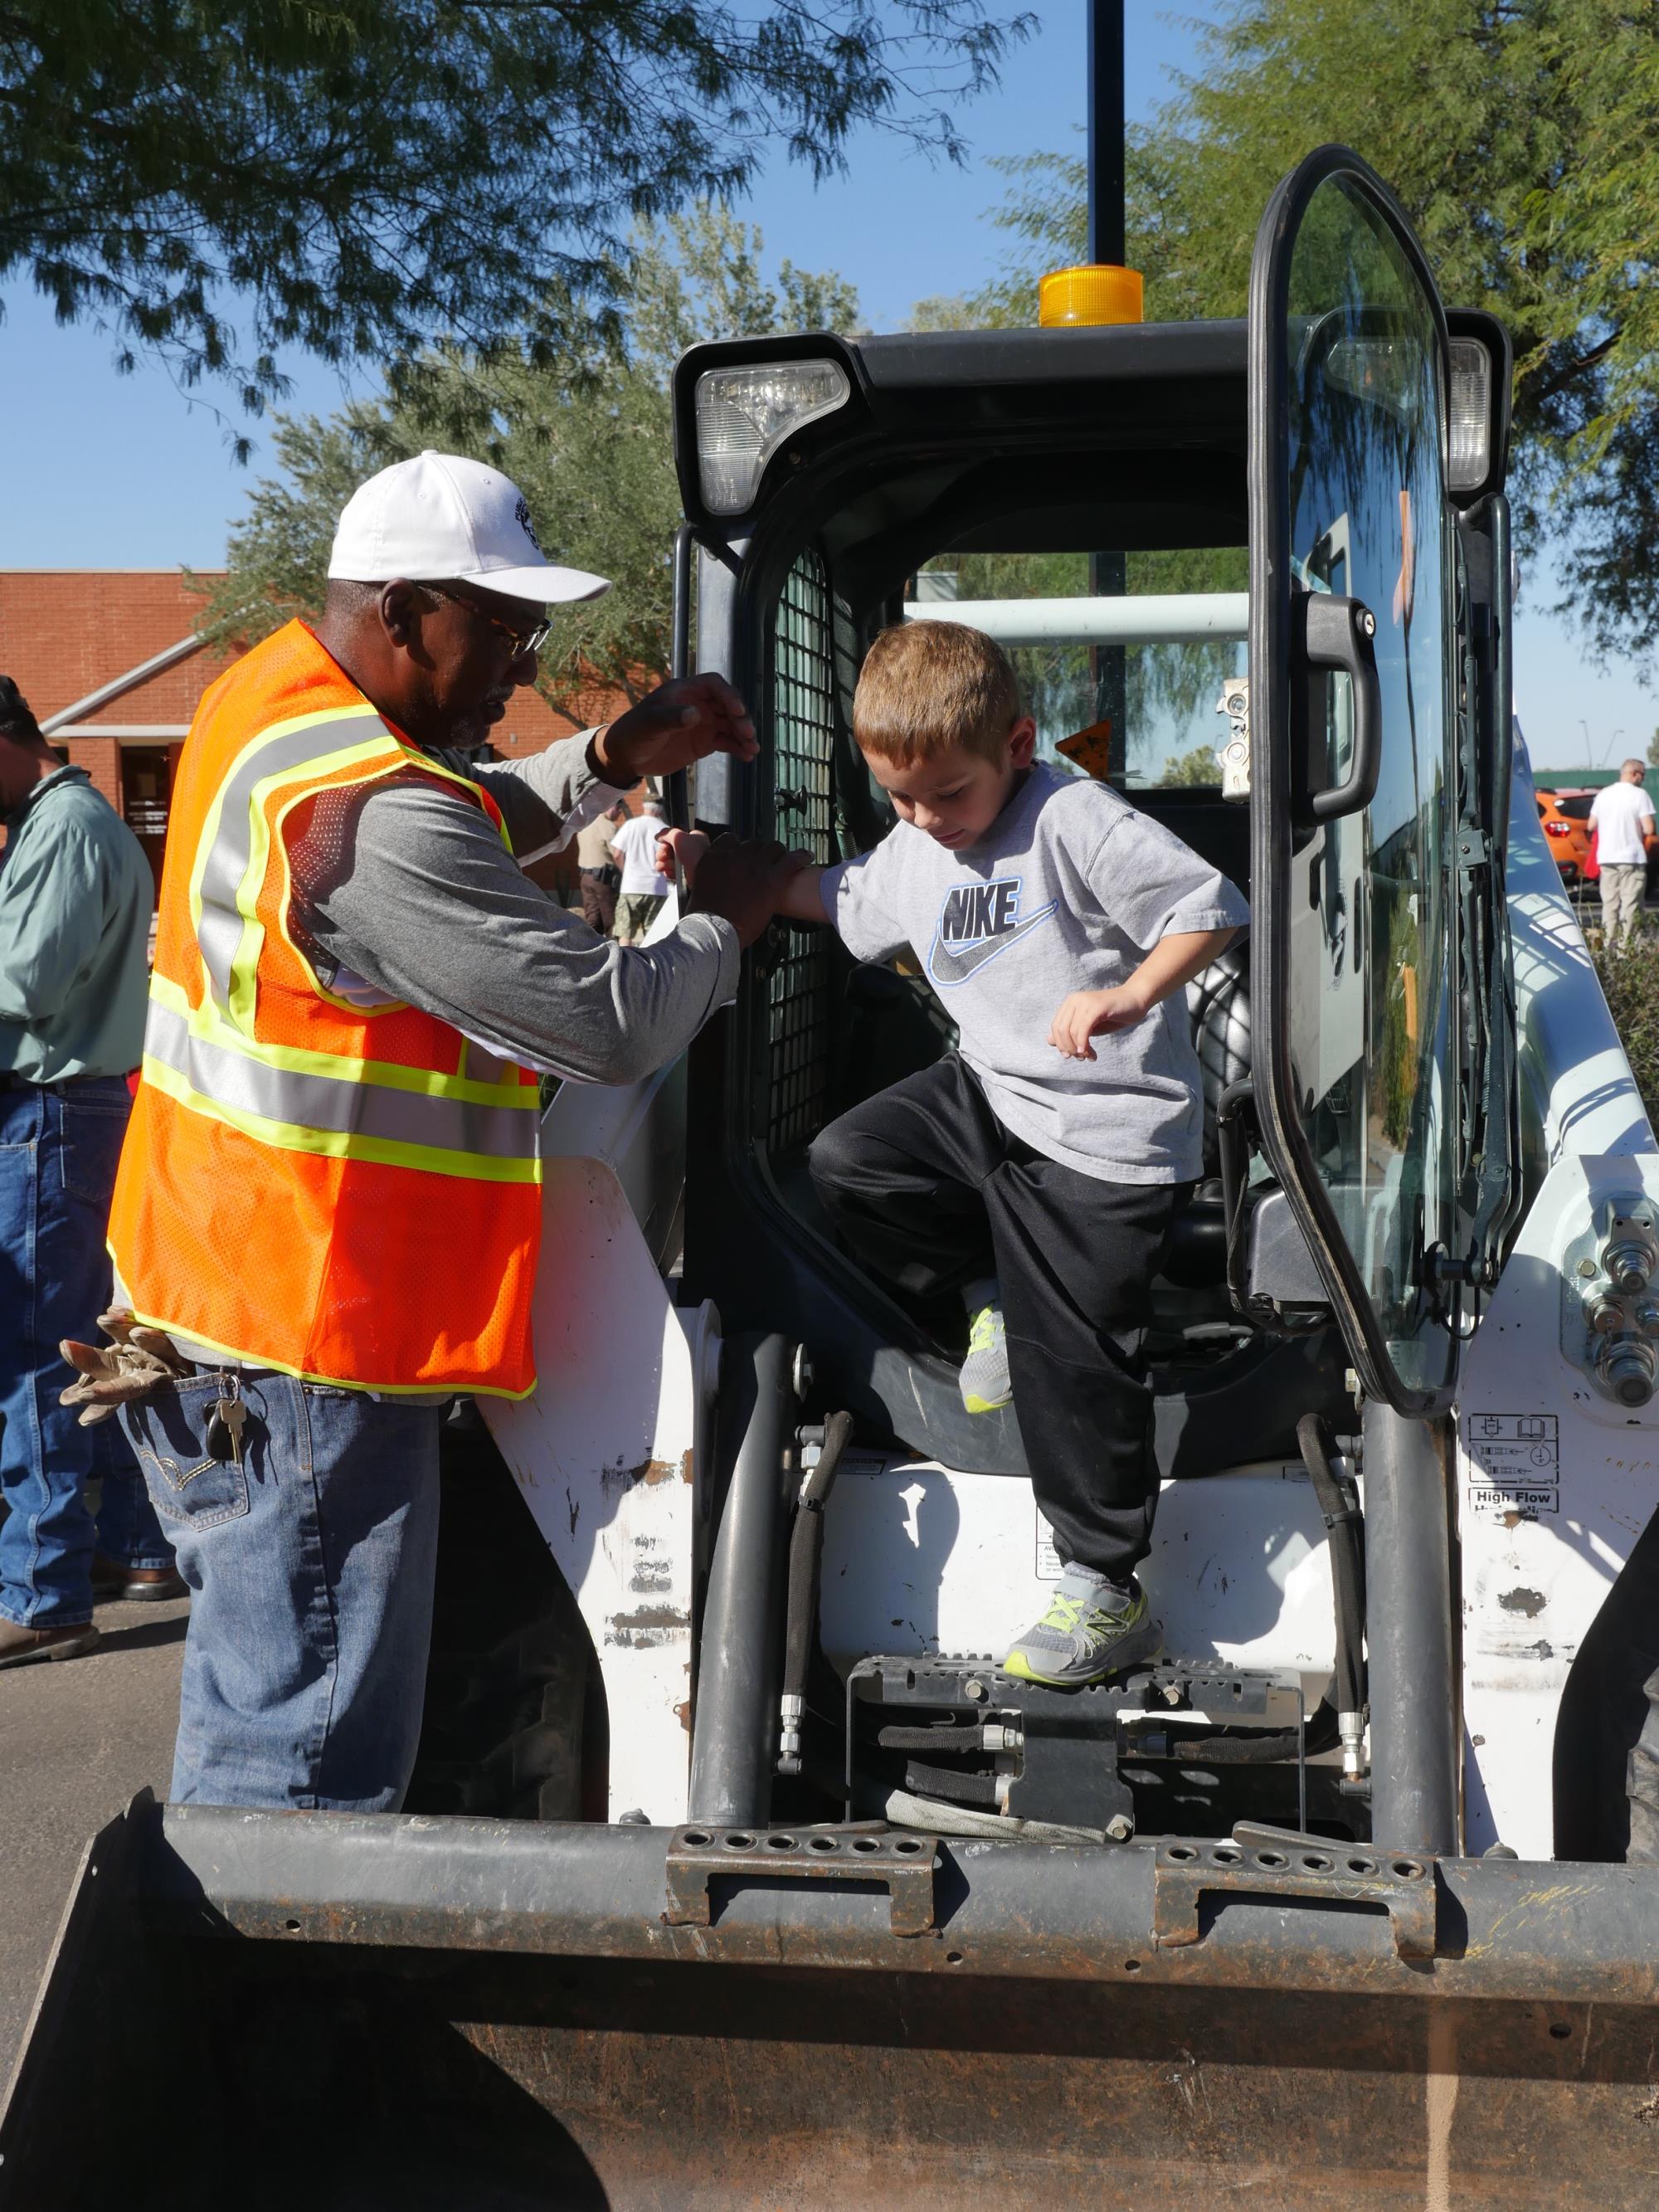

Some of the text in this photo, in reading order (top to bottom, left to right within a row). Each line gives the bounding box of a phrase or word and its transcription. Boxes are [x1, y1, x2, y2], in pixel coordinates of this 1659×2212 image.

[941, 879, 1020, 941] NIKE
[1477, 1491, 1550, 1504] High Flow
